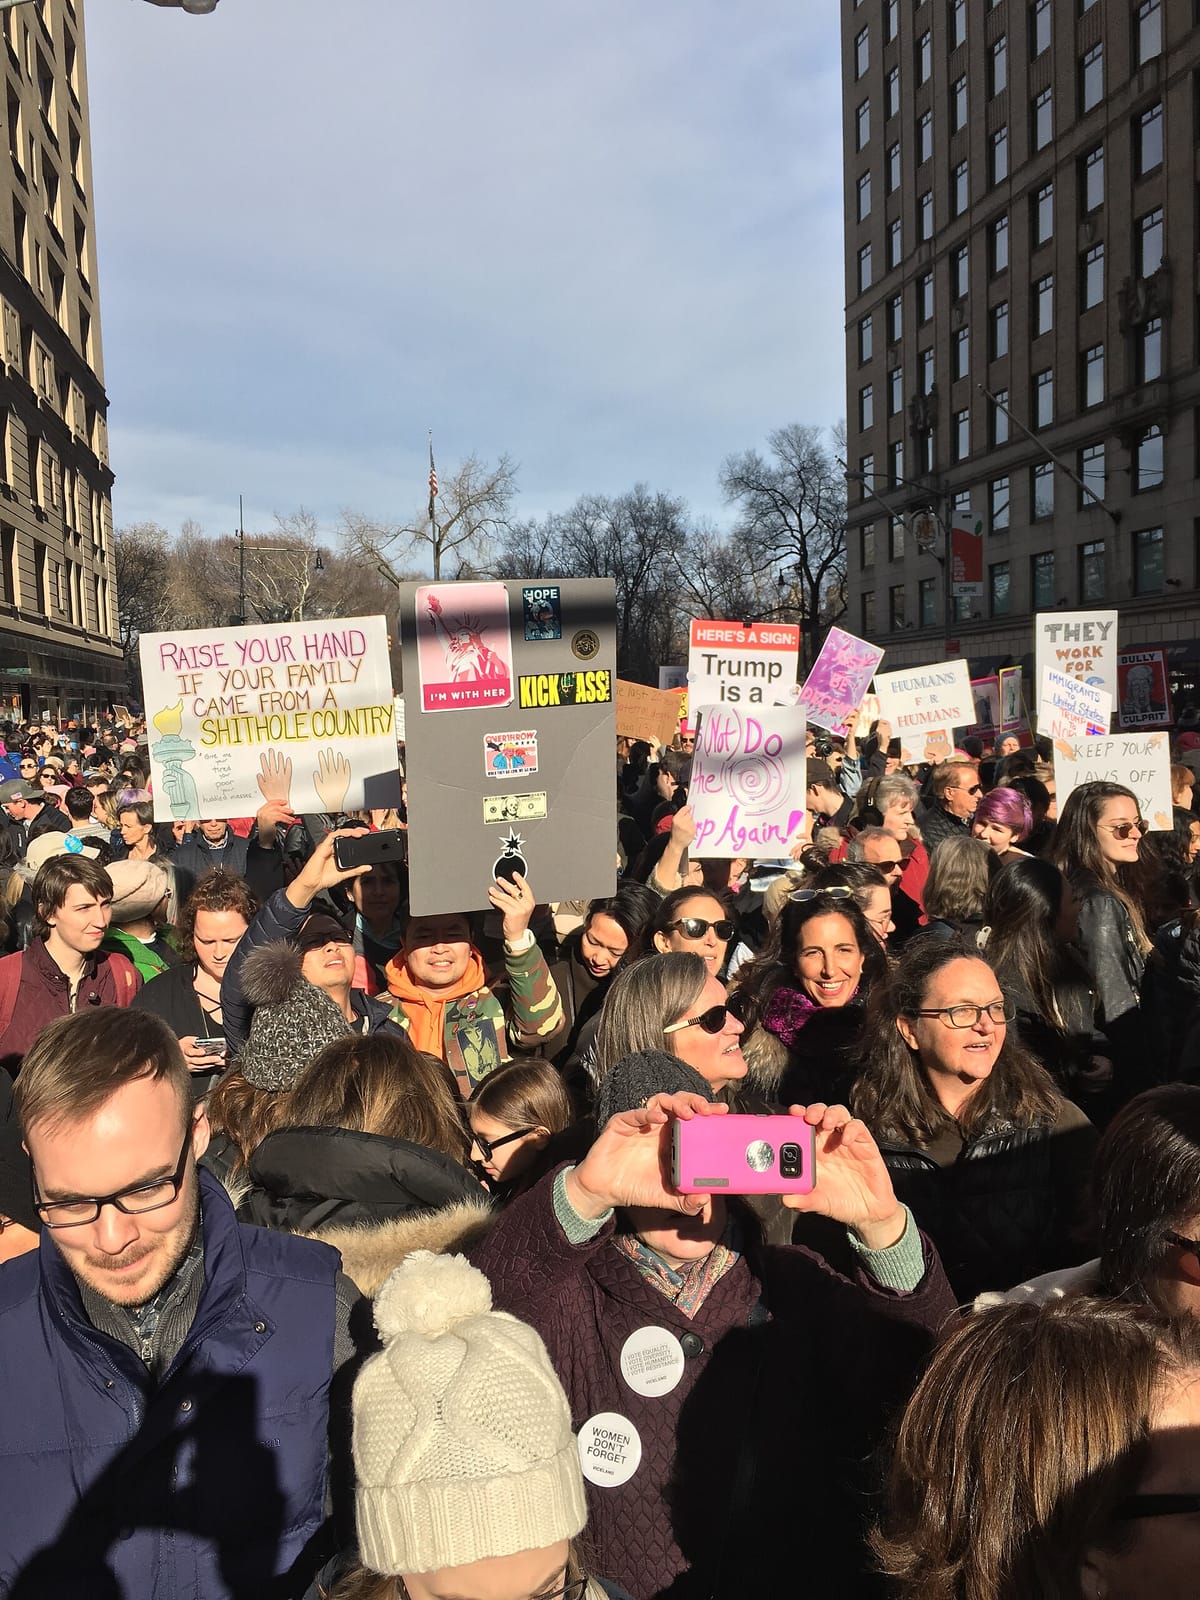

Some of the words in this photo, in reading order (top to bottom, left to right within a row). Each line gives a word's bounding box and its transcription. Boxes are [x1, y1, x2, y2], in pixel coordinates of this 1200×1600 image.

[523, 588, 558, 600] HOPE
[696, 629, 745, 642] HERE'S
[747, 630, 758, 643] A
[760, 630, 796, 645] SIGN:
[1044, 620, 1113, 643] THEY
[160, 642, 229, 671] RAISE
[235, 635, 295, 665] YOUR
[304, 630, 367, 659] HAND
[1056, 645, 1103, 659] WORK
[1121, 653, 1155, 664] BULLY
[177, 673, 203, 695] IF
[218, 667, 274, 692] YOUR
[288, 658, 362, 688] FAMILY
[701, 653, 782, 683] Trump
[1065, 660, 1093, 673] FOR
[519, 674, 560, 708] KICK
[720, 680, 740, 702] is
[749, 686, 763, 703] a
[829, 672, 849, 692] BE
[891, 672, 957, 693] HUMANS
[1048, 672, 1101, 703] IMMIGRANTS
[193, 694, 249, 717] CAME
[260, 690, 311, 713] FROM
[322, 688, 337, 708] A
[430, 688, 447, 702] I'M
[451, 689, 480, 701] WITH
[483, 688, 506, 698] HER
[1053, 692, 1077, 713] United
[200, 712, 308, 745] SHITHOLE
[312, 705, 394, 739] COUNTRY
[897, 706, 961, 728] HUMANS
[1123, 712, 1165, 723] CULPRIT
[485, 731, 535, 743] OVERTHROW
[744, 717, 783, 757] Do
[1074, 742, 1114, 758] KEEP
[1122, 741, 1153, 756] YOUR
[1074, 769, 1119, 786] LAWS
[1129, 769, 1157, 783] OFF
[714, 804, 804, 852] Again!
[592, 1426, 630, 1445] WOMEN
[593, 1437, 625, 1453] DON'T
[587, 1446, 627, 1464] FORGET
